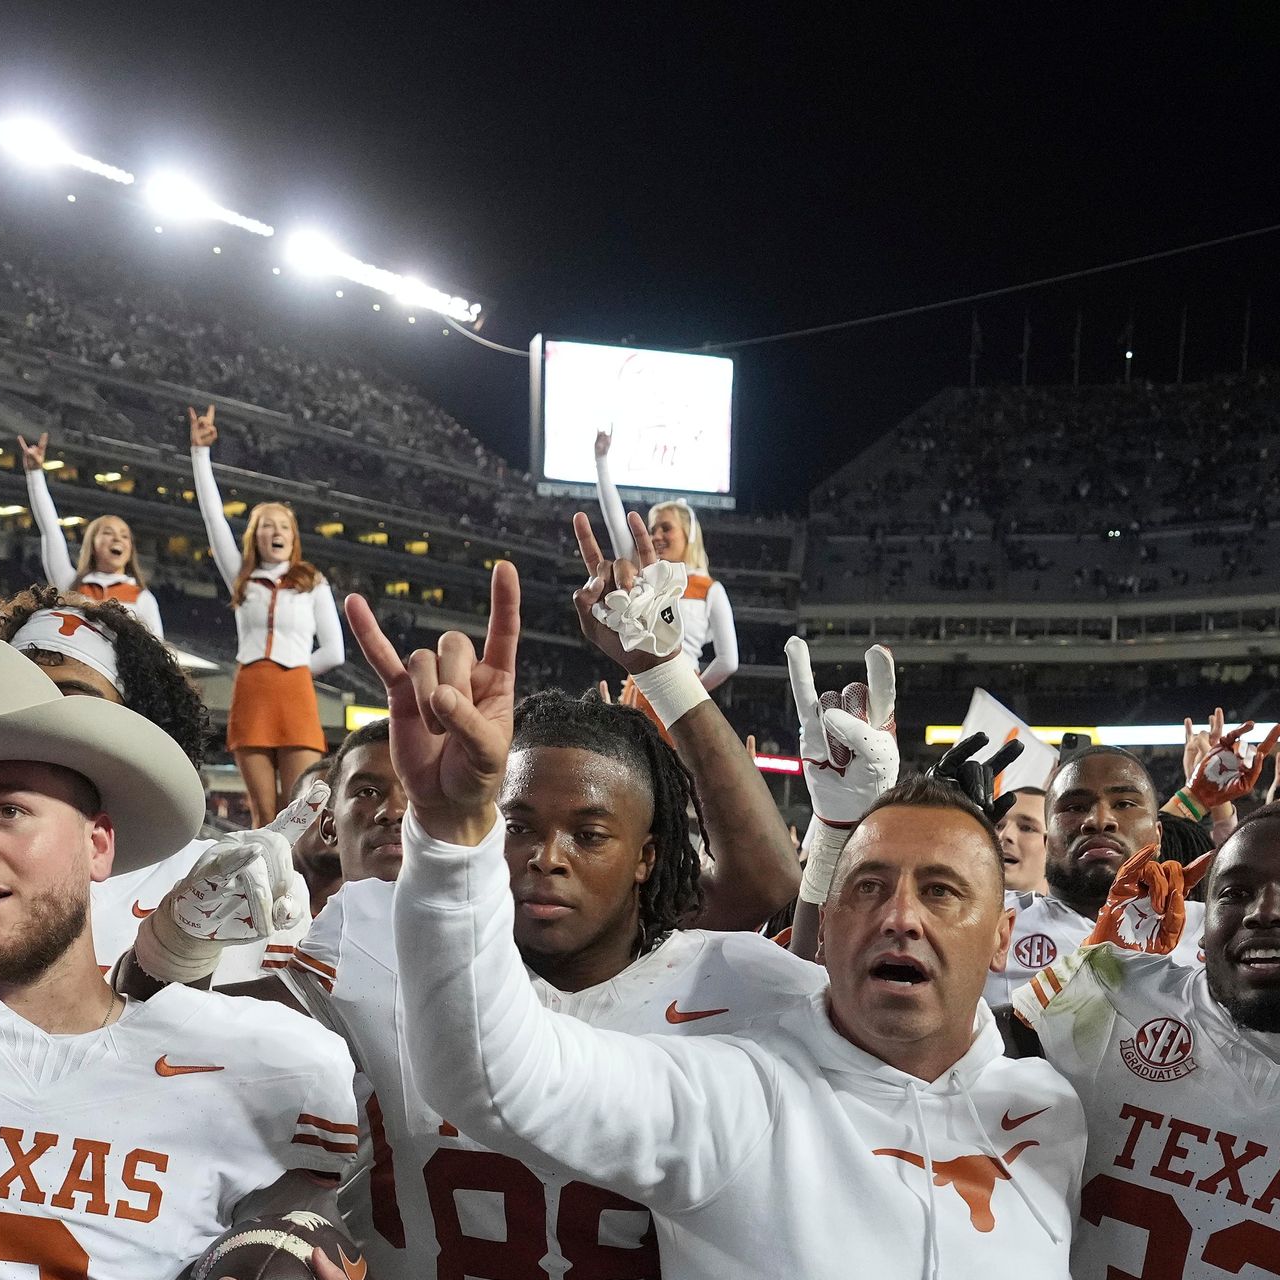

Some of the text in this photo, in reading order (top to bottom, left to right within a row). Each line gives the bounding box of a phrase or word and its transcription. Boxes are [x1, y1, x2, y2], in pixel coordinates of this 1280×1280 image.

[1015, 934, 1057, 968] SEC
[1137, 1018, 1192, 1066] SEC
[1124, 1051, 1182, 1080] GRADUATE
